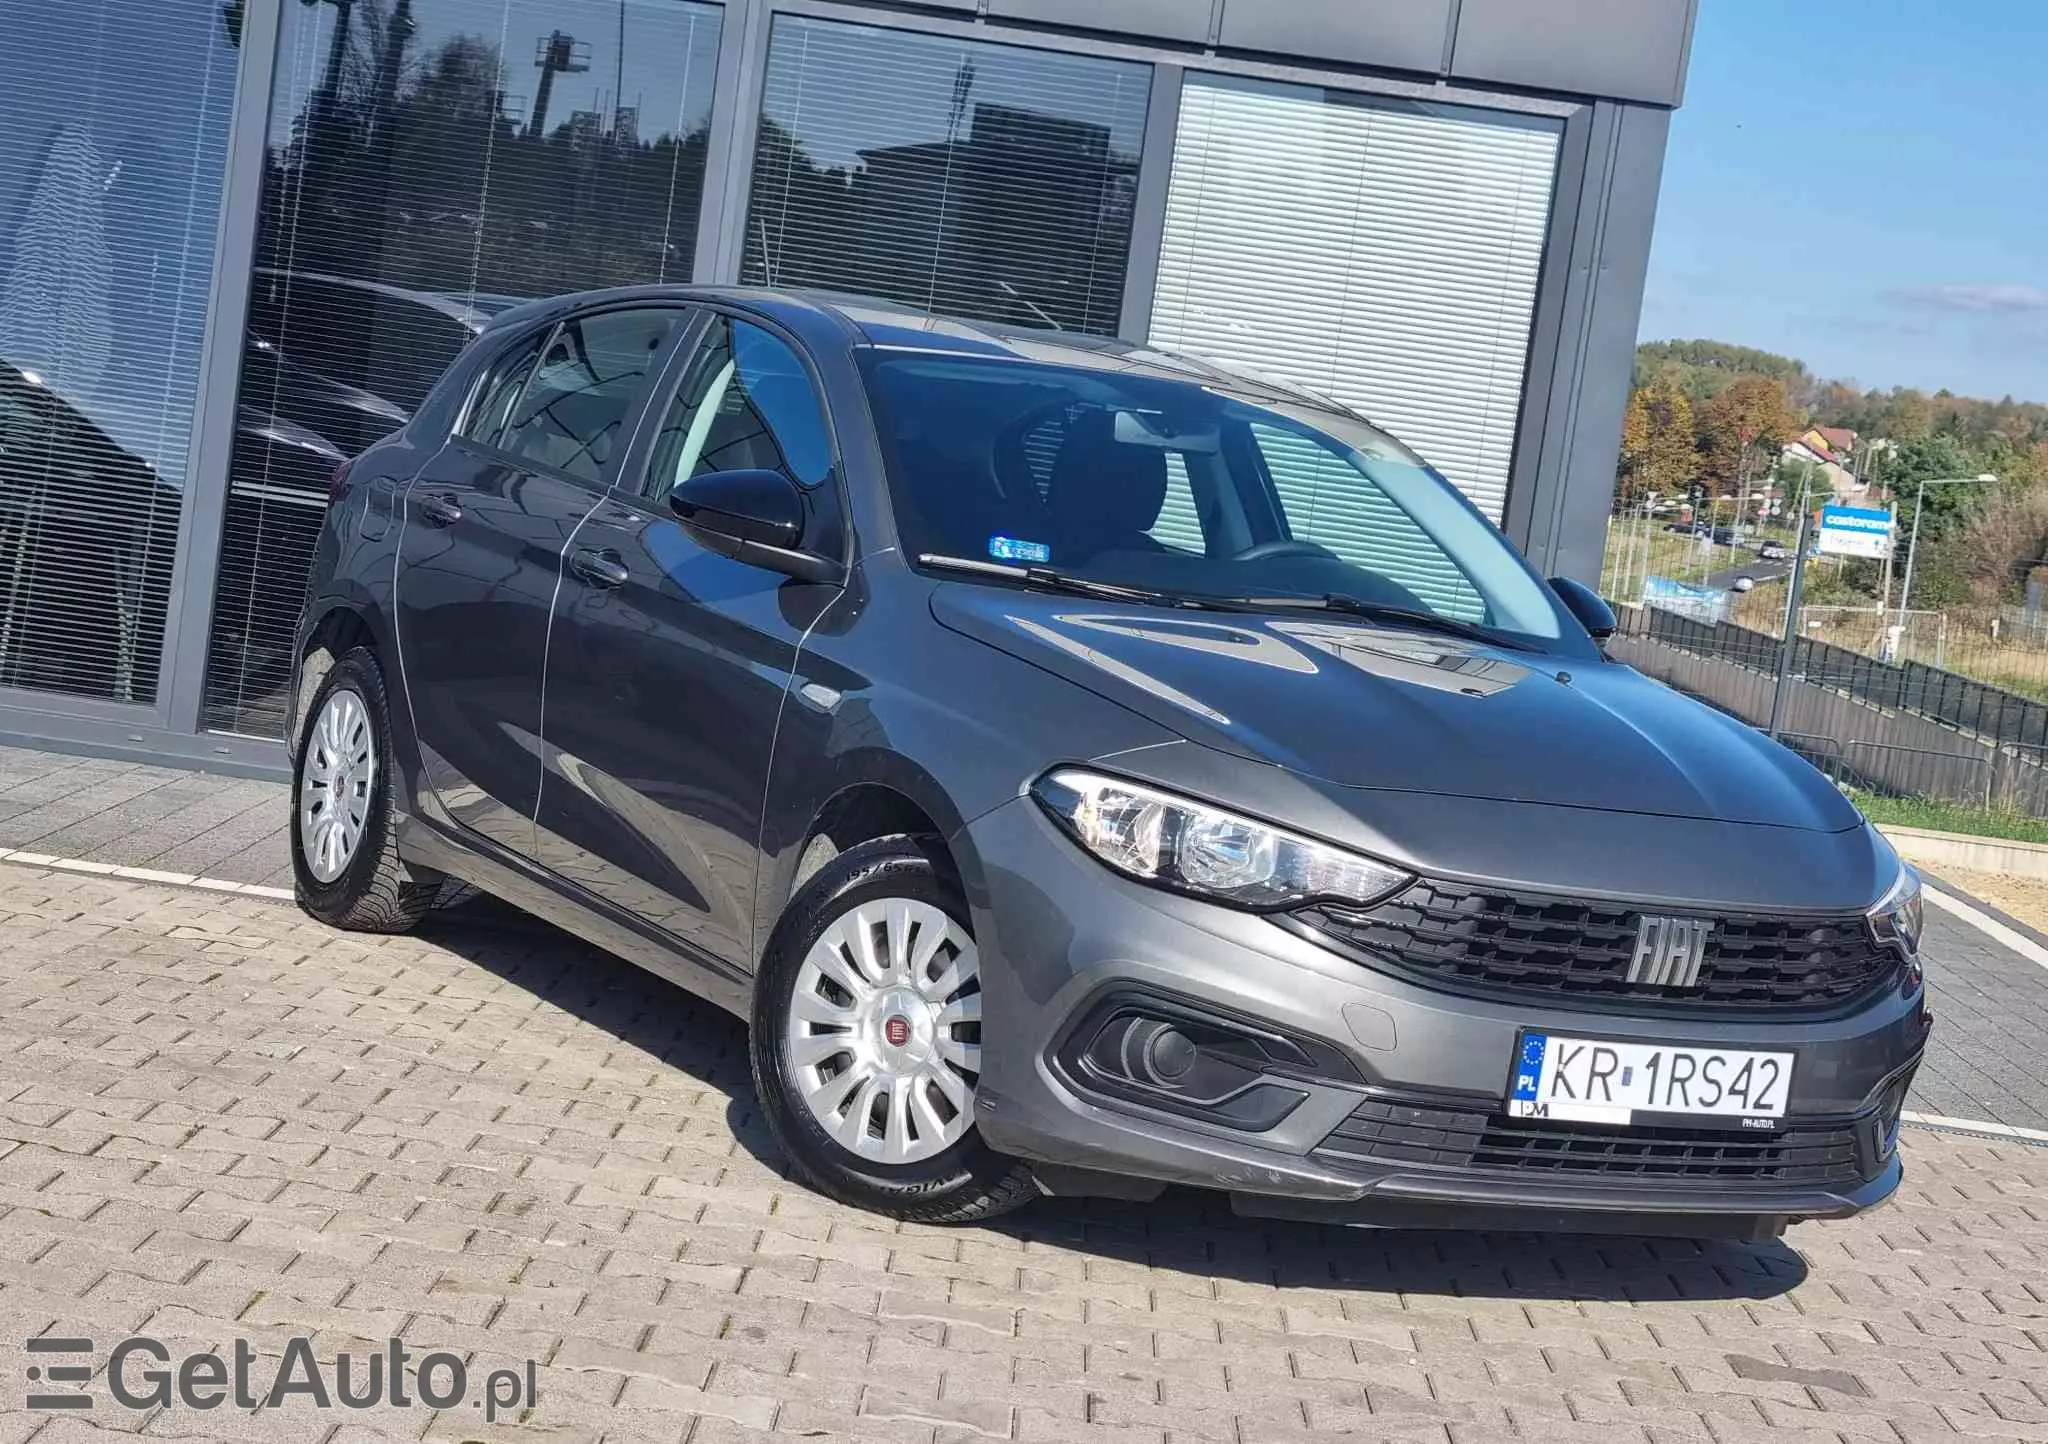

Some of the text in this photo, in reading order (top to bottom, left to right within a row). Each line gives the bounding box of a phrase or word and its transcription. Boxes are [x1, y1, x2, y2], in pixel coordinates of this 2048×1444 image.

[1626, 916, 1715, 987] FIAT
[1517, 1075, 1537, 1092] PL
[1551, 1043, 1779, 1110] KR 1RS42
